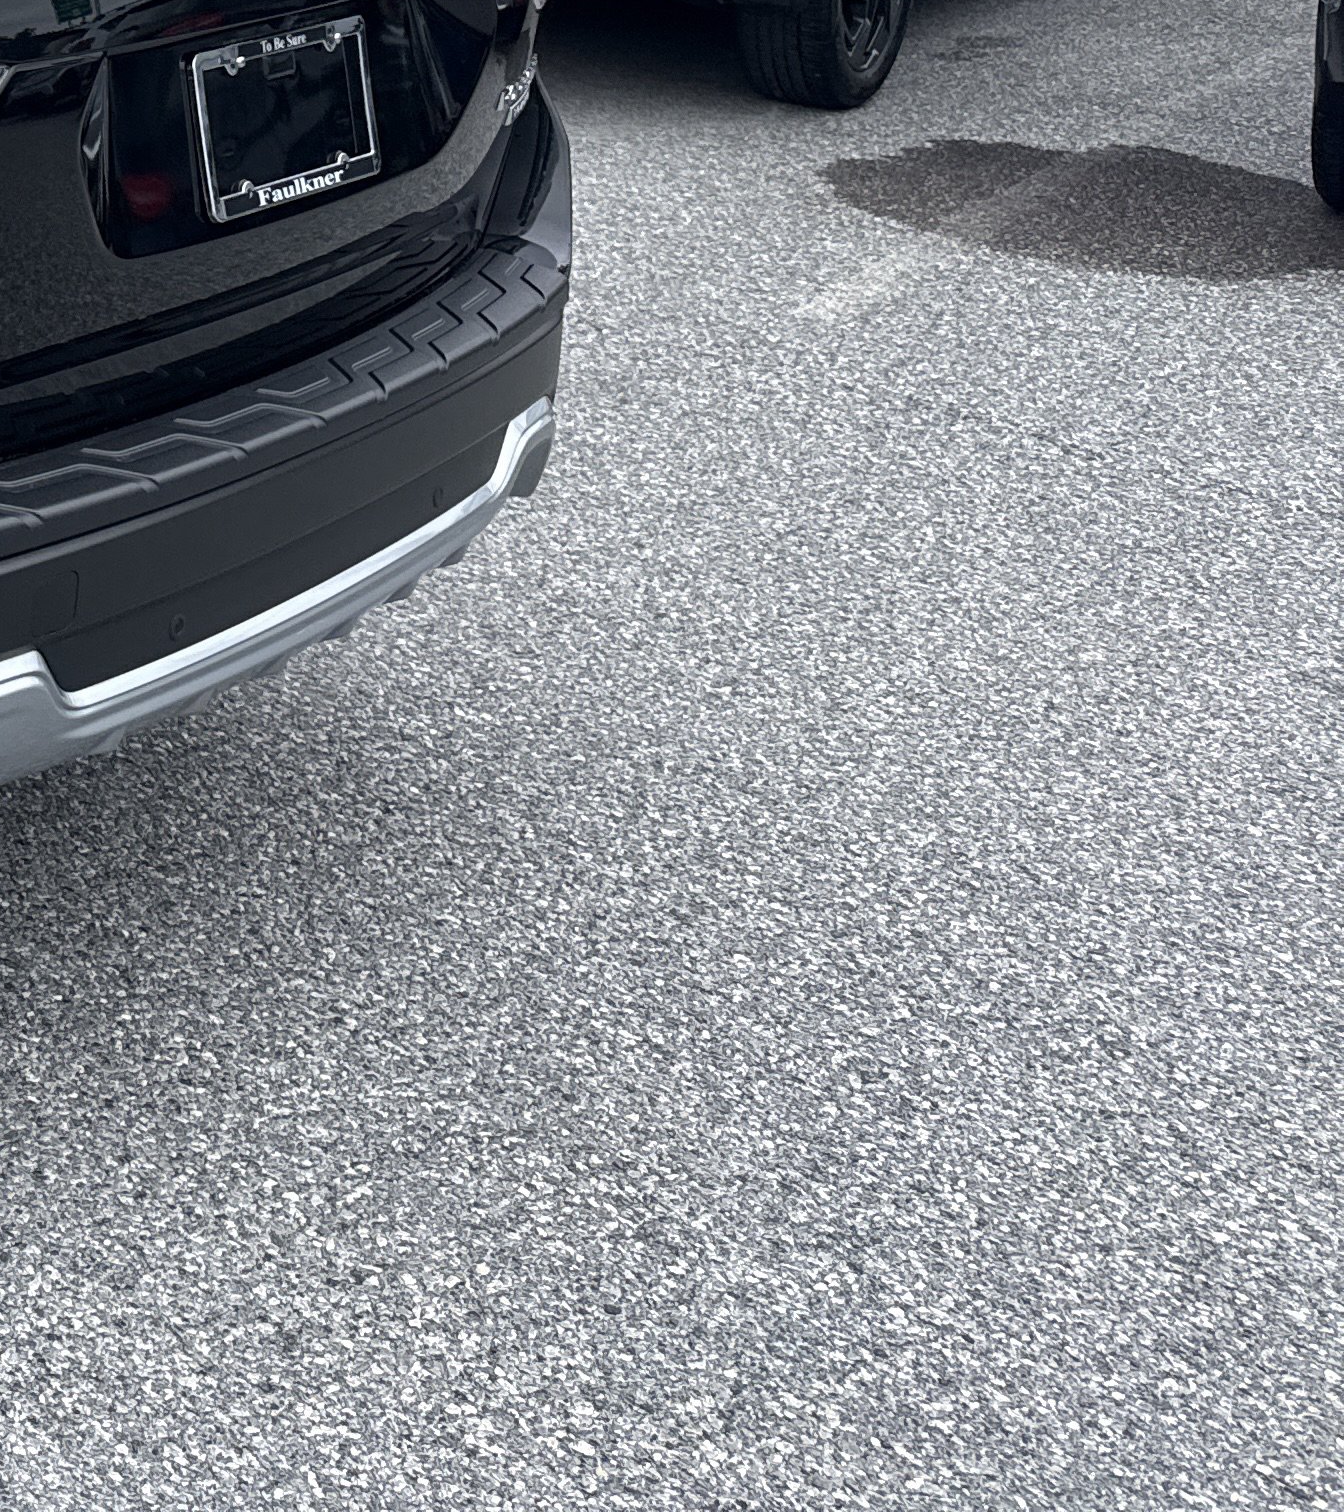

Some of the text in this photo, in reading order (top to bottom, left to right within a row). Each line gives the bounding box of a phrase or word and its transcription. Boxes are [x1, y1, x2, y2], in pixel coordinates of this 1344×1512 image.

[260, 34, 306, 53] To Be Sure
[257, 170, 344, 206] Faulkner
